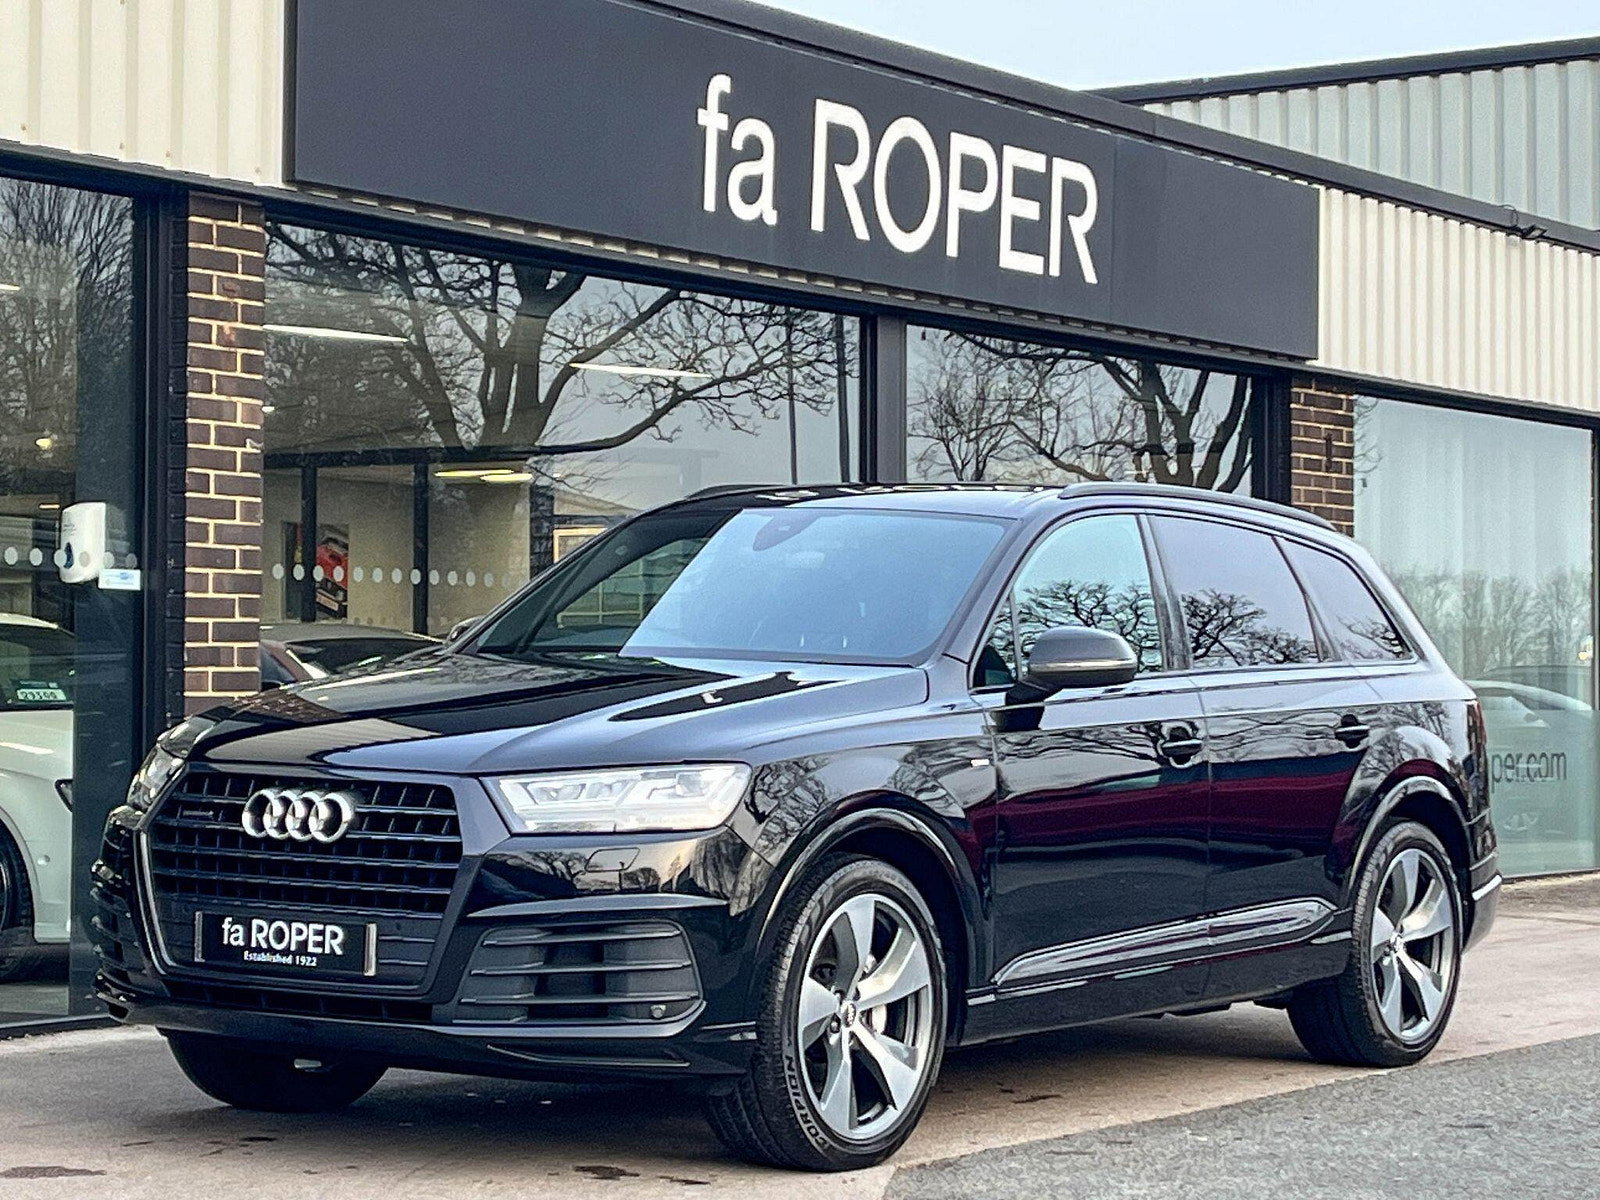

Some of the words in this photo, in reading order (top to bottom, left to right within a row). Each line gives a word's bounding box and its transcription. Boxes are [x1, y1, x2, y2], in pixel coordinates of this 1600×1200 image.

[697, 73, 778, 226] fa
[810, 98, 1099, 285] ROPER
[221, 917, 245, 946] fa
[250, 918, 344, 955] ROPER
[243, 950, 293, 965] Established
[295, 955, 317, 967] 1922
[785, 1055, 831, 1150] CORPION
